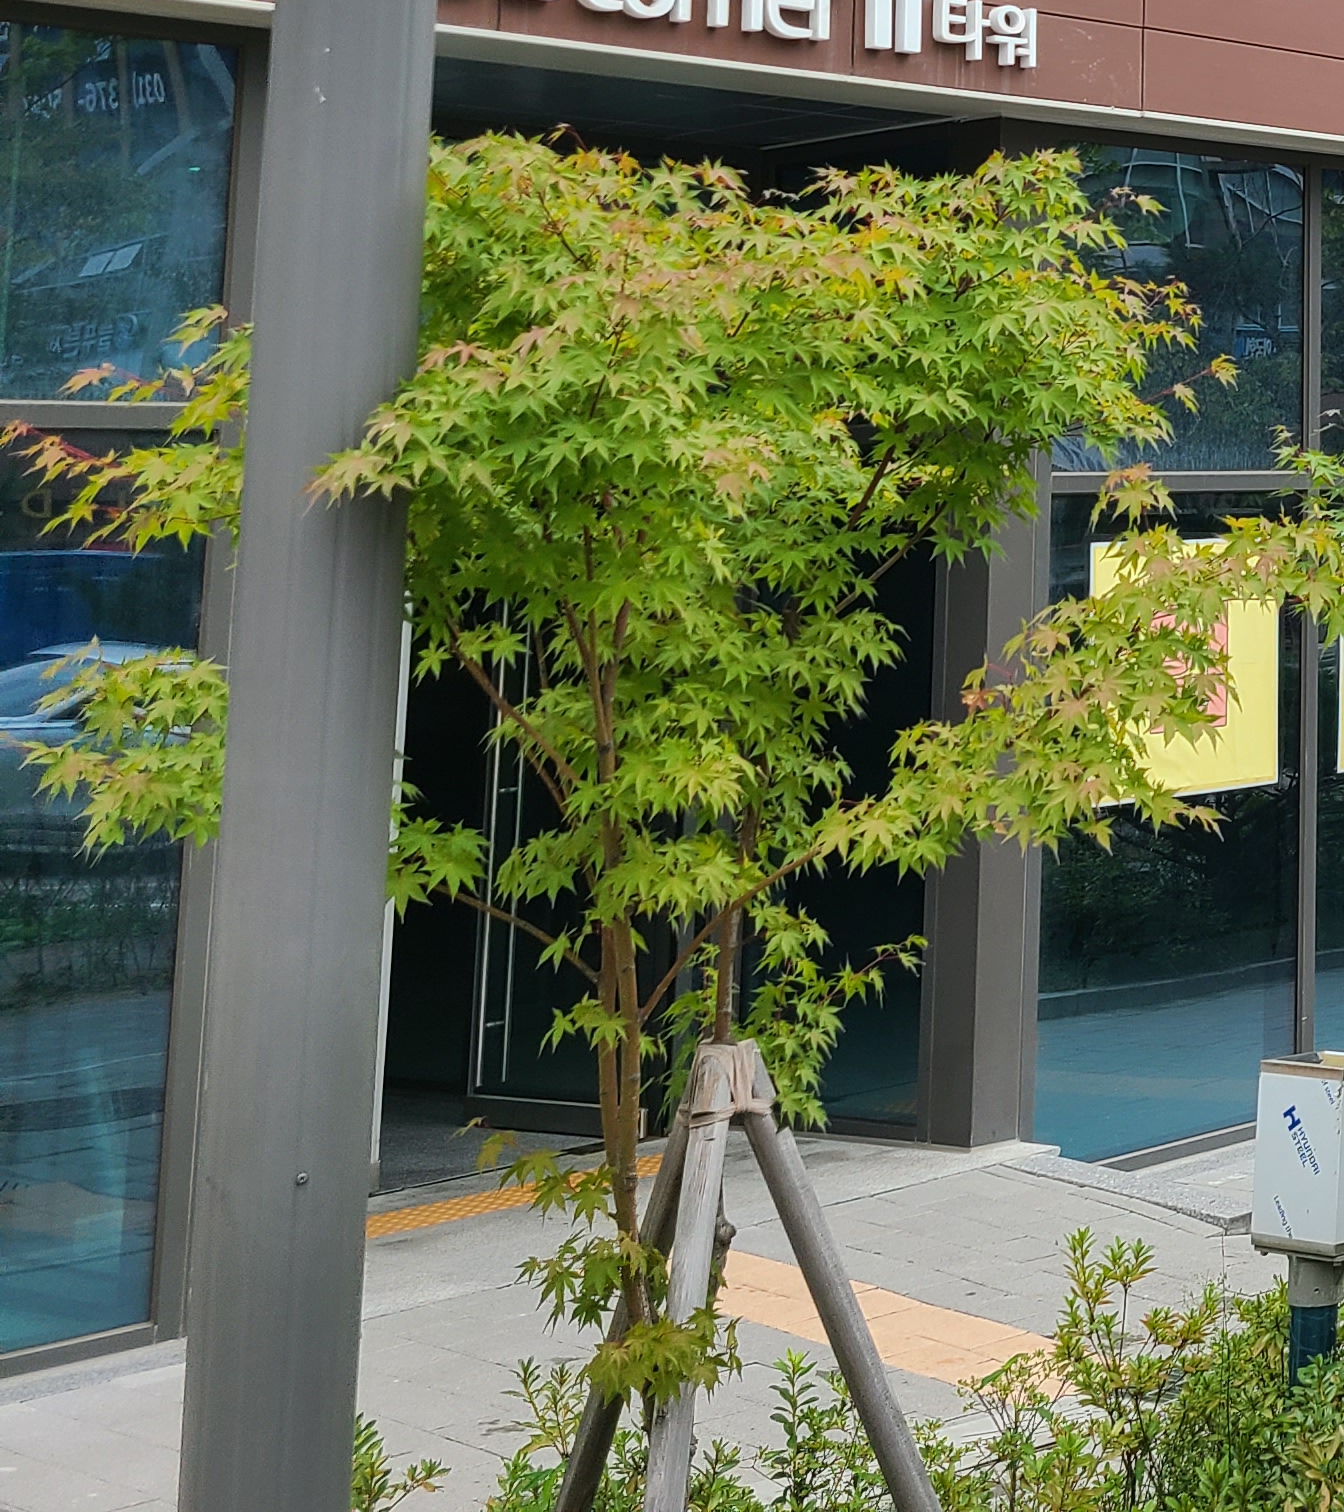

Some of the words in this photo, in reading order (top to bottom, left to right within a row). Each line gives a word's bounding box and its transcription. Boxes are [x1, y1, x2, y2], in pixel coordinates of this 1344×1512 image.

[1291, 1131, 1308, 1169] STEEL
[1297, 1126, 1321, 1176] HYUNDAI
[1273, 1194, 1289, 1228] Leading
